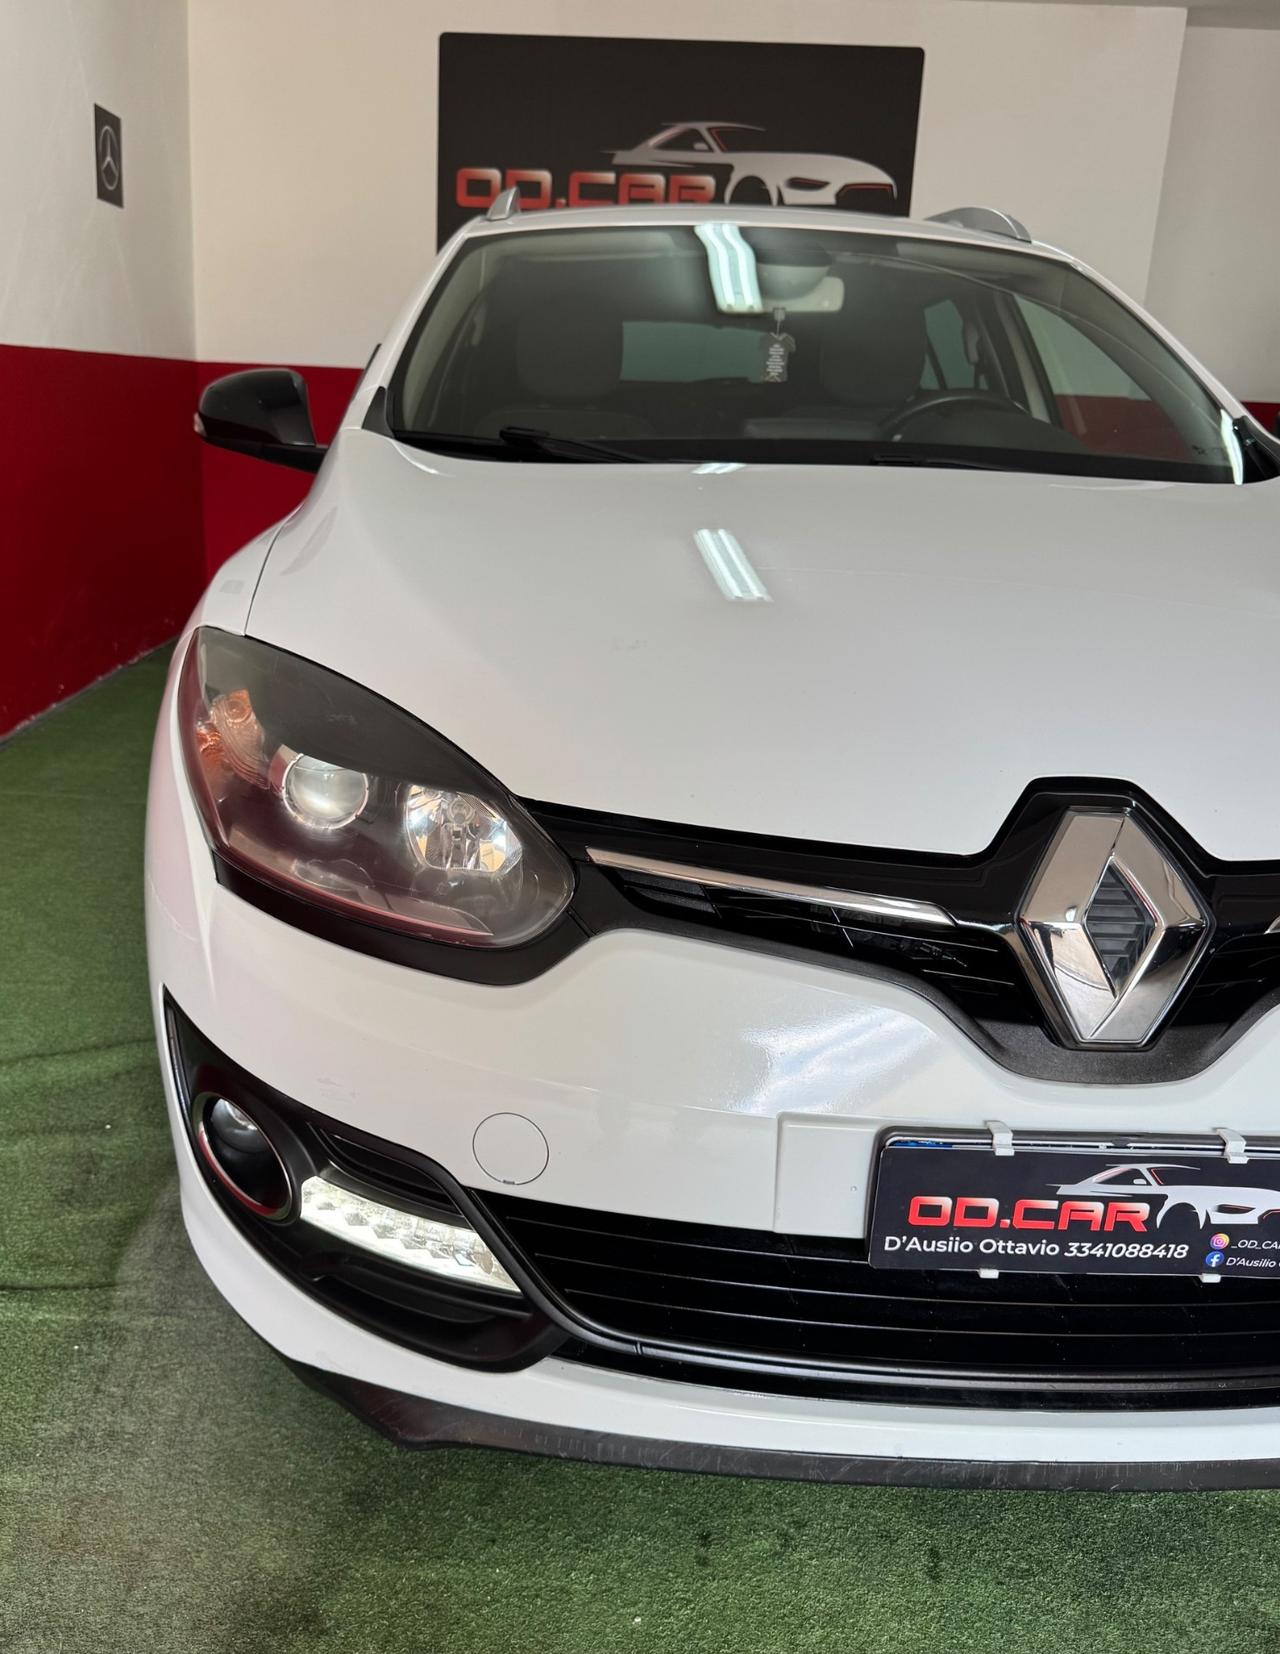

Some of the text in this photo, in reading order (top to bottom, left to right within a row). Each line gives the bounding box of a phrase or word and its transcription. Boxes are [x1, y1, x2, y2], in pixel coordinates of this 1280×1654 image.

[908, 1196, 1150, 1232] OD.CAR
[979, 1238, 1060, 1256] Ottavio
[1064, 1241, 1189, 1259] 3341088418
[1231, 1239, 1280, 1250] _OD_CA
[1226, 1257, 1277, 1268] D'Ausilio
